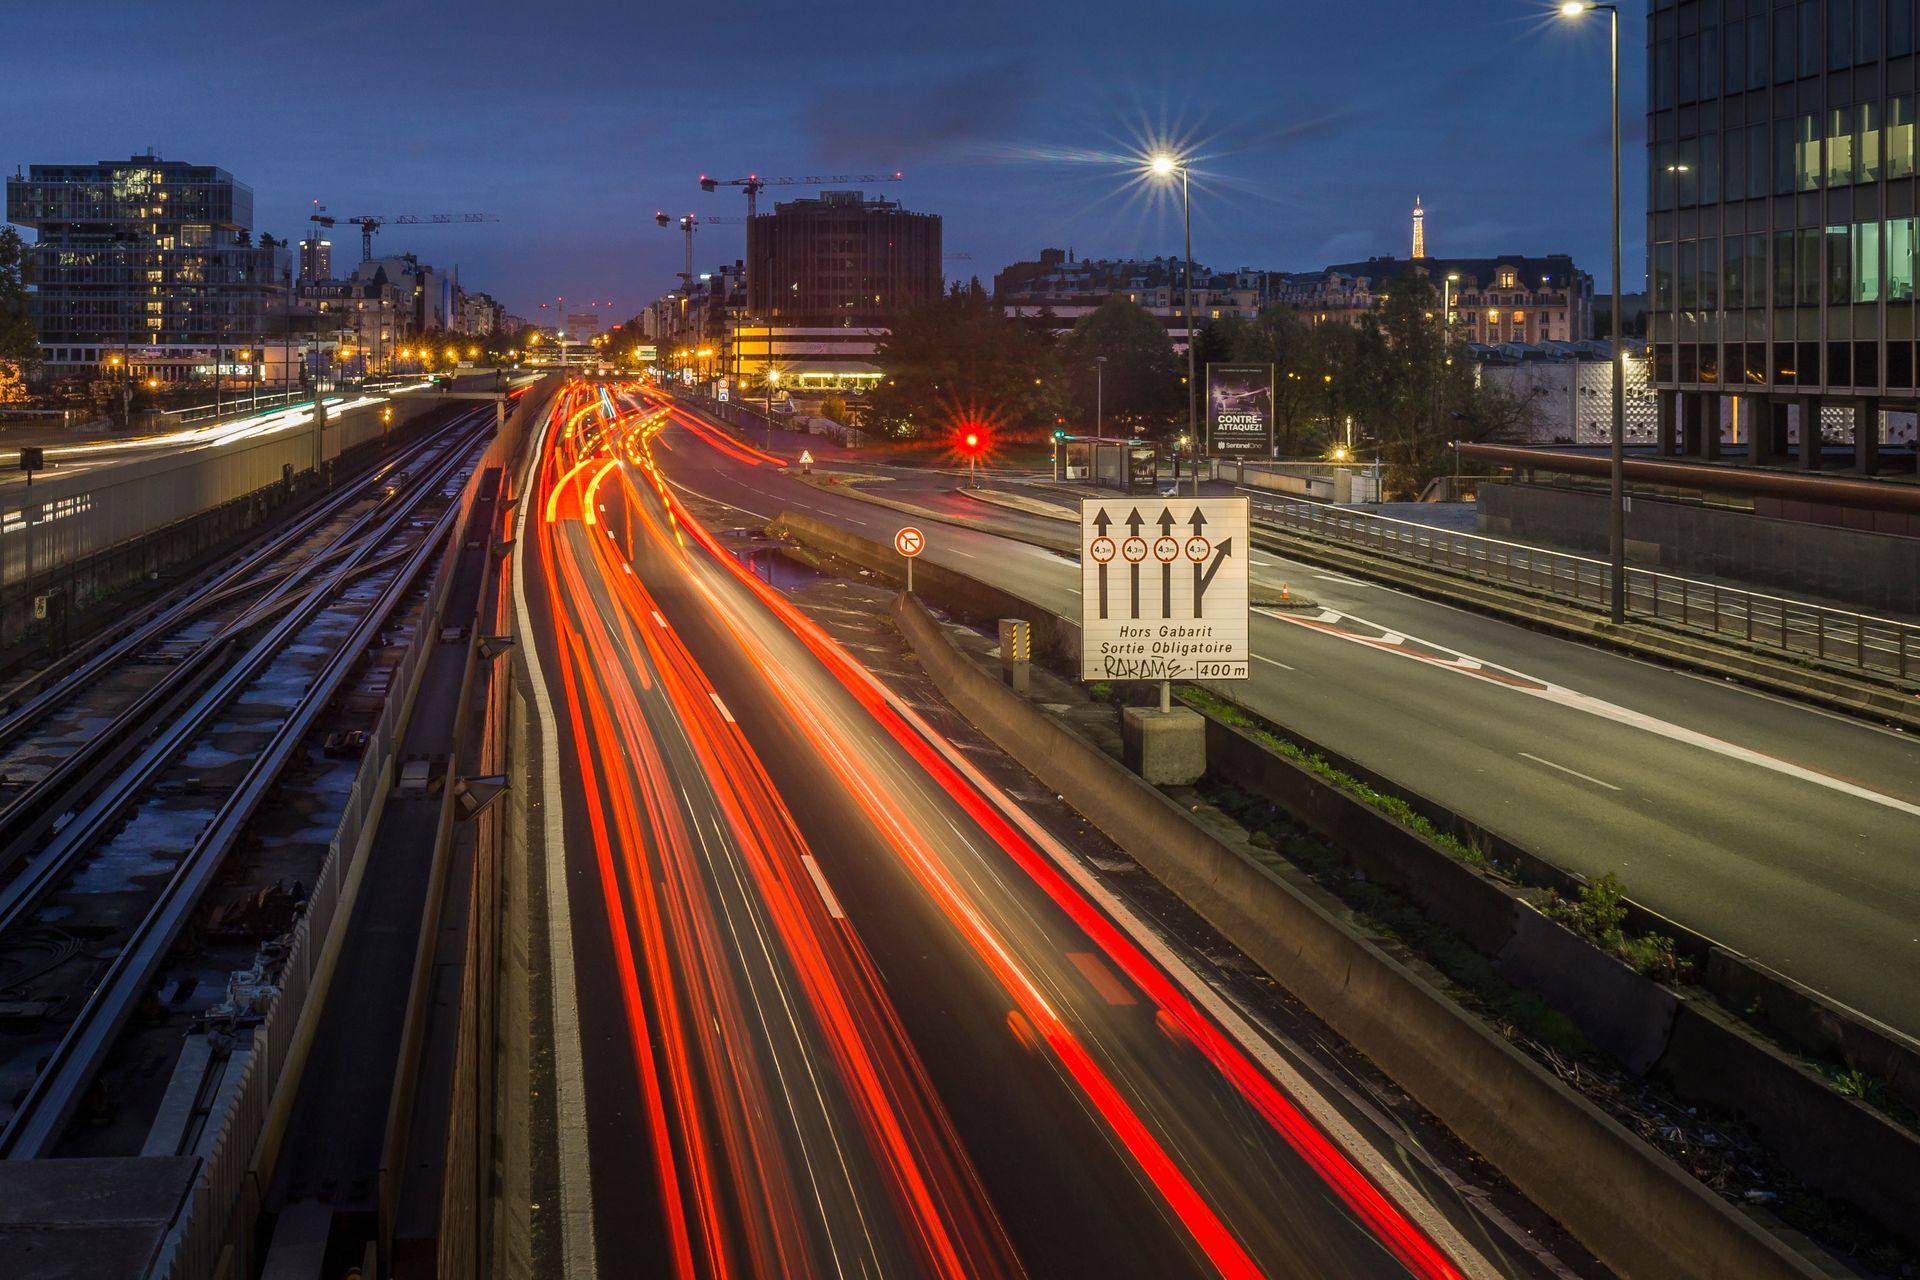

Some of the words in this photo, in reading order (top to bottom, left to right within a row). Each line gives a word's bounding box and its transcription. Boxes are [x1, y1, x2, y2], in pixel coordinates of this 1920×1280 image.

[1217, 415, 1262, 424] CONTRE-
[1119, 625, 1151, 637] Hors
[1159, 625, 1213, 637] Gabarit
[1100, 642, 1145, 654] Sortie
[1152, 641, 1233, 656] Obligatoire
